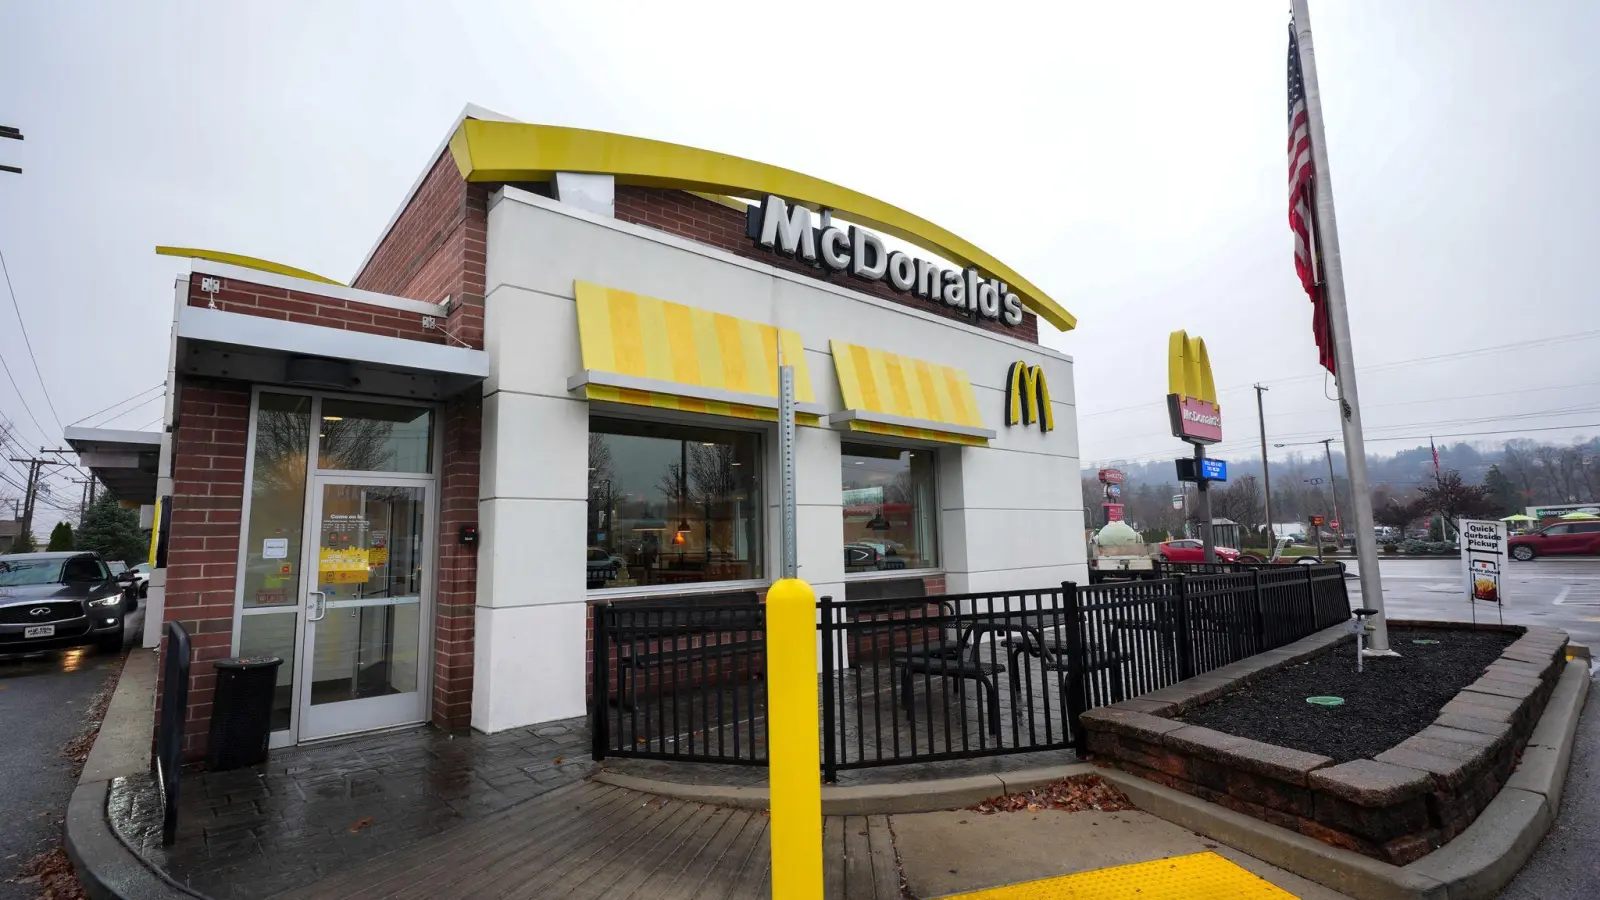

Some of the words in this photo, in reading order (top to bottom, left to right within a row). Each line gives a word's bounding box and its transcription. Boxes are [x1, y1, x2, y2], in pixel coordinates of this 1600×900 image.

[759, 194, 1023, 327] McDonald's
[1183, 409, 1222, 427] McDonald's
[1470, 525, 1494, 533] Quick
[1464, 532, 1502, 541] Curbside
[1469, 539, 1498, 549] Pickup
